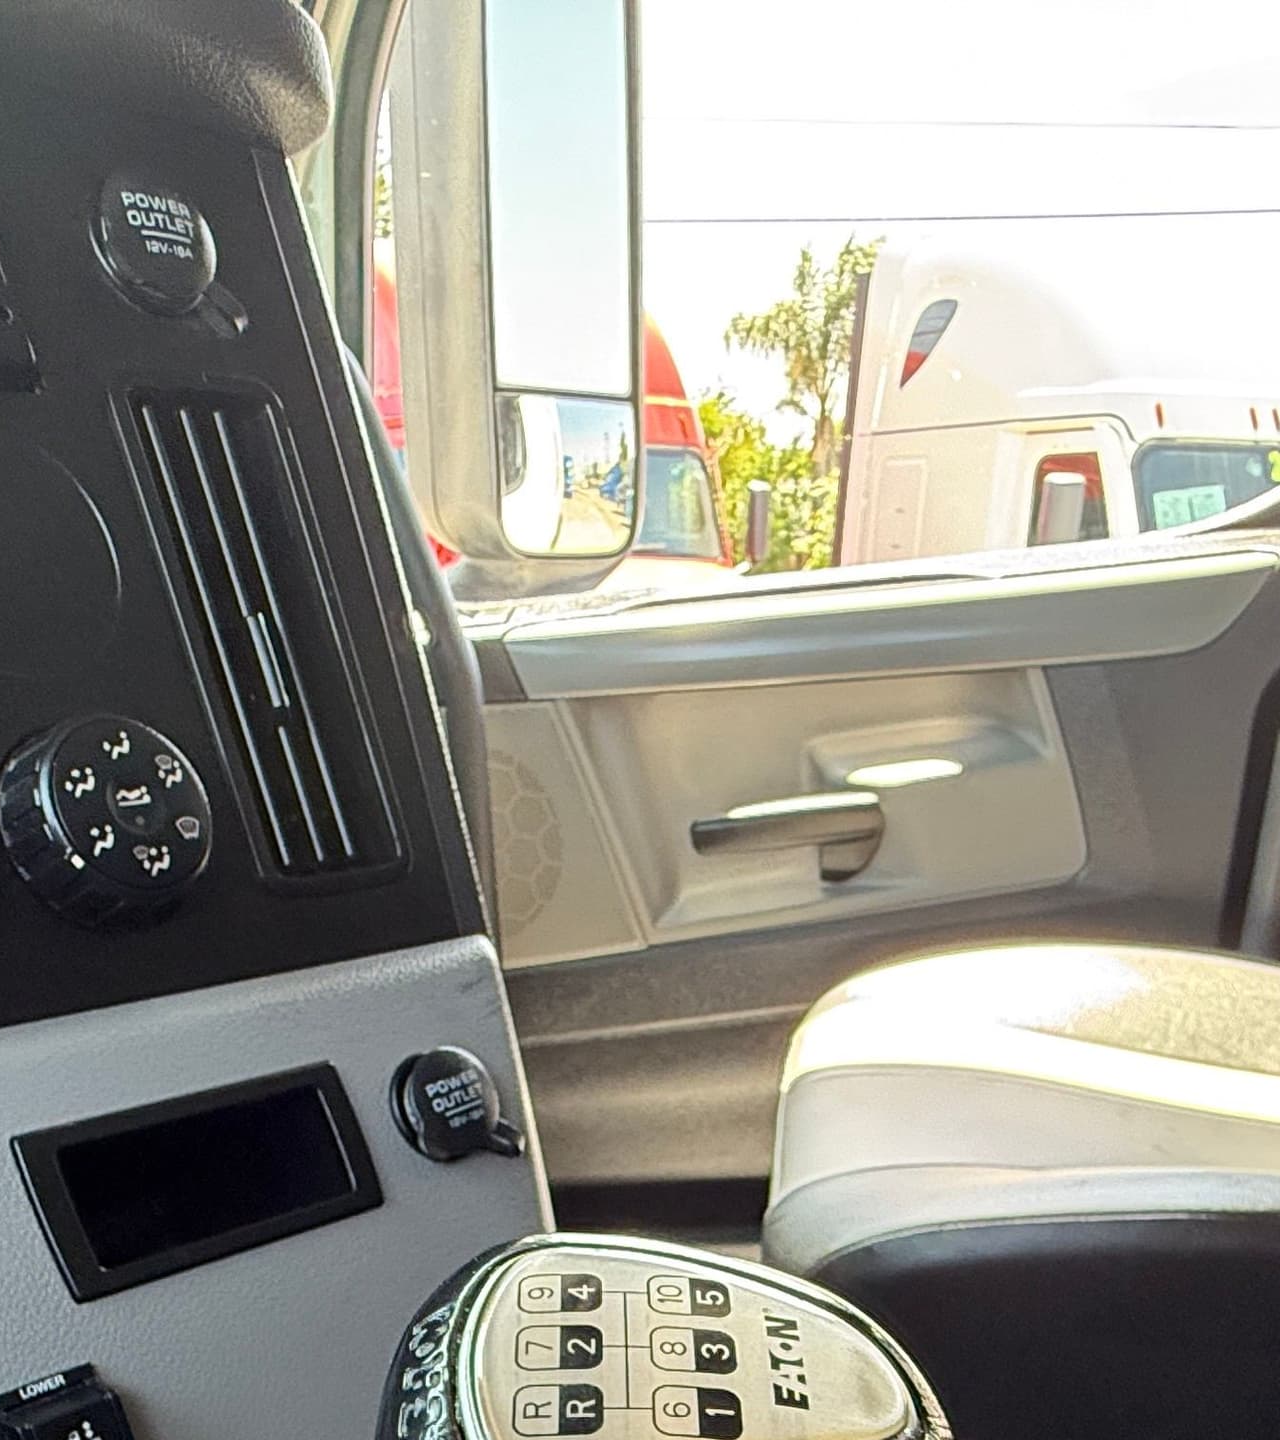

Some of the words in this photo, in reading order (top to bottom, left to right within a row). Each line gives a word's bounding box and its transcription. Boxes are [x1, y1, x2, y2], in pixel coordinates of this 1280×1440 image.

[121, 191, 191, 219] POWER
[126, 209, 194, 238] OUTLET
[425, 1067, 479, 1098] POWER
[431, 1082, 483, 1112] OUTLET
[528, 1286, 554, 1299] 9
[567, 1284, 596, 1300] 4
[657, 1284, 683, 1304] 10
[696, 1289, 724, 1306] 5
[525, 1340, 553, 1355] 7
[567, 1337, 597, 1354] 2
[659, 1341, 687, 1355] 8
[701, 1343, 730, 1360] 3
[764, 1315, 810, 1410] EATON
[19, 1374, 66, 1400] LOWER
[523, 1401, 552, 1419] R
[566, 1399, 596, 1418] R
[663, 1402, 691, 1417] 6
[705, 1408, 735, 1417] 1
